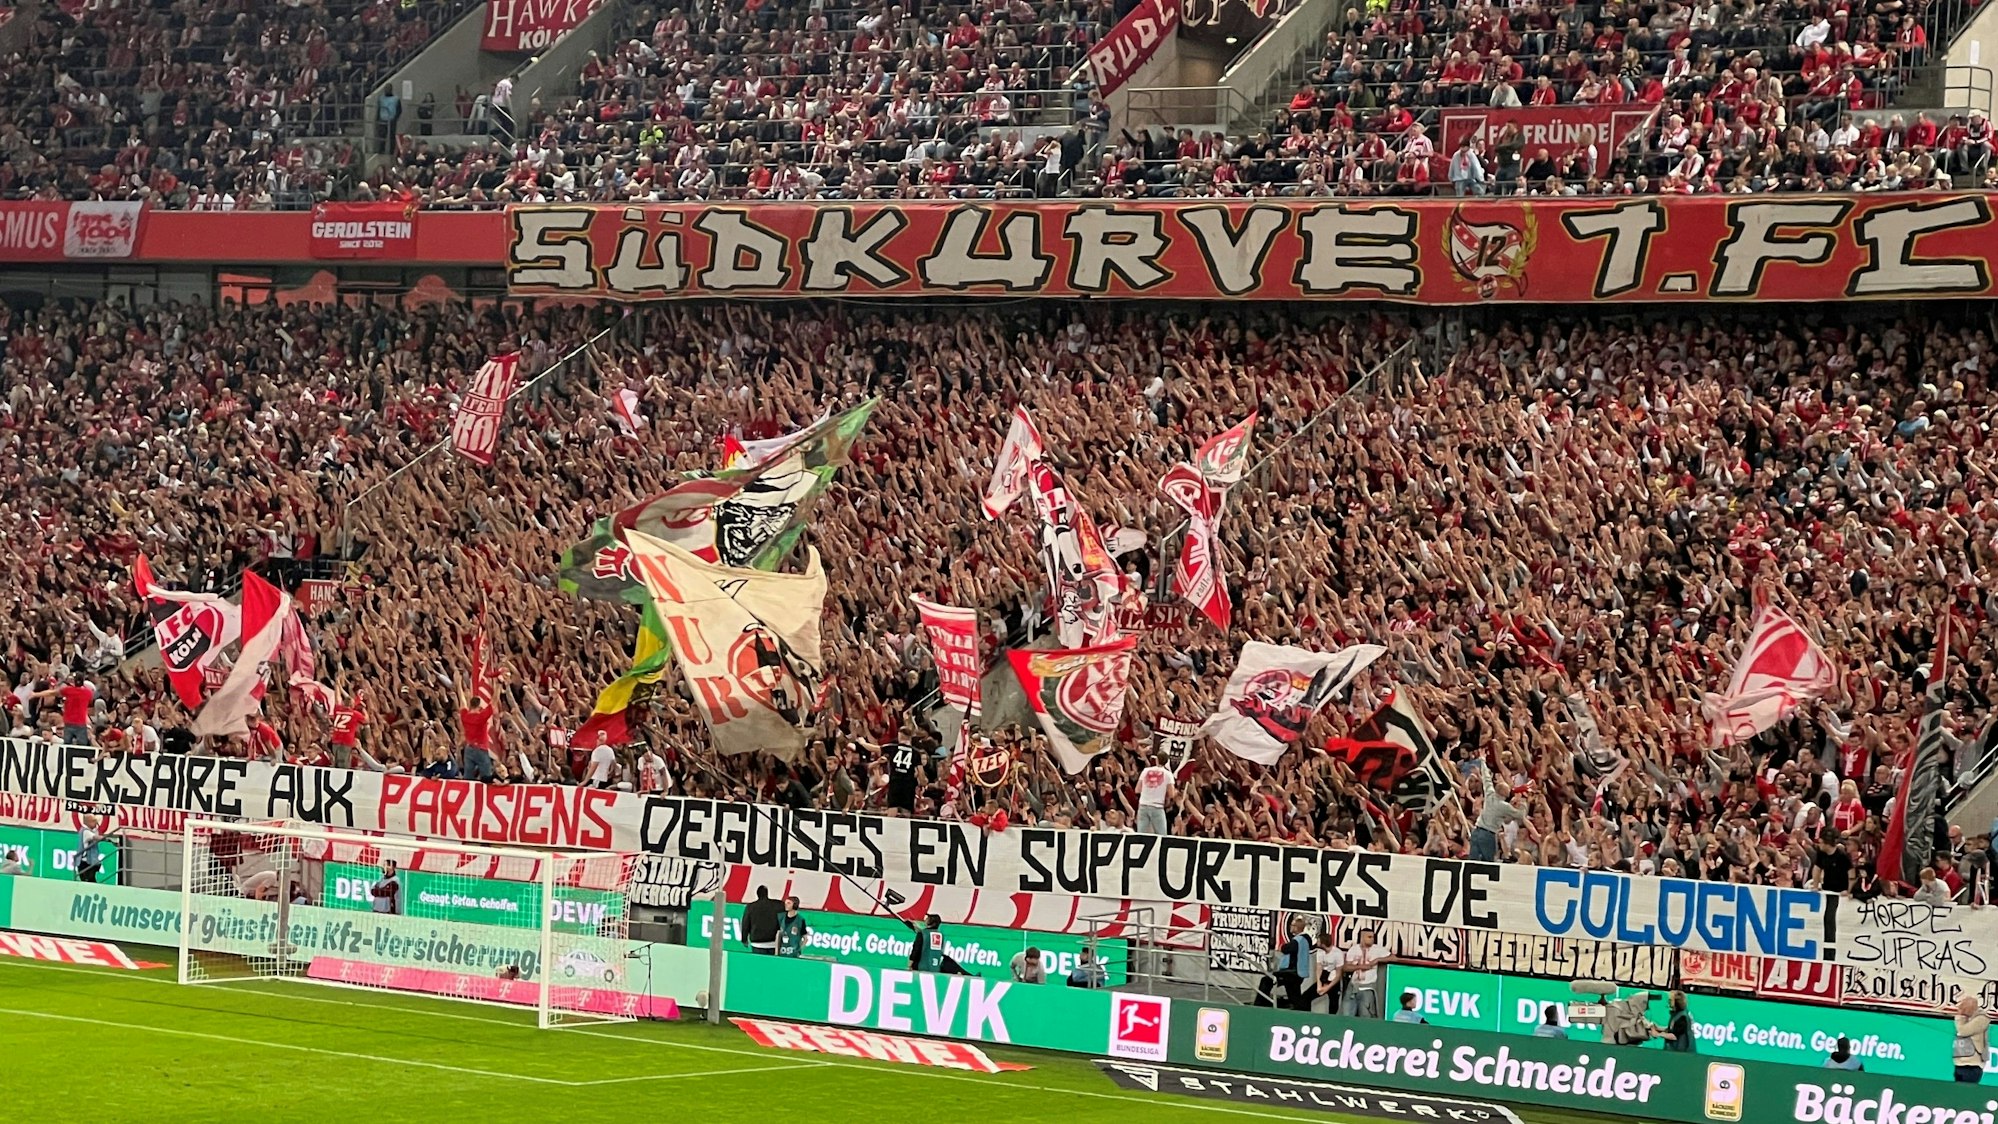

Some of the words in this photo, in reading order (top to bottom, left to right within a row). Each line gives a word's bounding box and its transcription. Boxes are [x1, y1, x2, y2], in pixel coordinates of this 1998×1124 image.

[0, 211, 59, 249] MUS
[312, 221, 412, 239] GEROLSTEIN
[1559, 197, 1997, 298] 1.FC
[1476, 235, 1507, 267] 12
[169, 627, 203, 665] KÖLN
[333, 714, 352, 729] 12
[893, 750, 913, 769] 44
[268, 765, 354, 827] AUX
[378, 775, 618, 849] PARISIENS
[640, 797, 884, 879] DEGUISES
[910, 821, 988, 887] EN
[1019, 829, 1392, 919] SUPPORTERS
[1422, 858, 1501, 929] DE
[1535, 868, 1840, 961] COLOGNE!
[635, 856, 697, 886] STADT
[551, 900, 608, 925] DEVK
[630, 884, 690, 907] VERBOT
[70, 893, 108, 924] Mit
[202, 908, 319, 948] günstien
[1857, 901, 1962, 933] HORDE
[804, 927, 862, 956] Gesagt.
[1468, 929, 1673, 988] VEEDELSRADAU
[1847, 934, 1987, 976] SUPRAS
[828, 964, 1013, 1043] DEVK
[1845, 965, 1963, 1009] Kölsche
[754, 1020, 973, 1070] REWE
[1116, 1044, 1160, 1056] BUNDESLIGA
[1742, 1023, 1806, 1050] Getan.
[1810, 1030, 1905, 1061] Geolfen.
[1268, 1025, 1441, 1079] Bäckerei
[1449, 1045, 1662, 1103] Schneider
